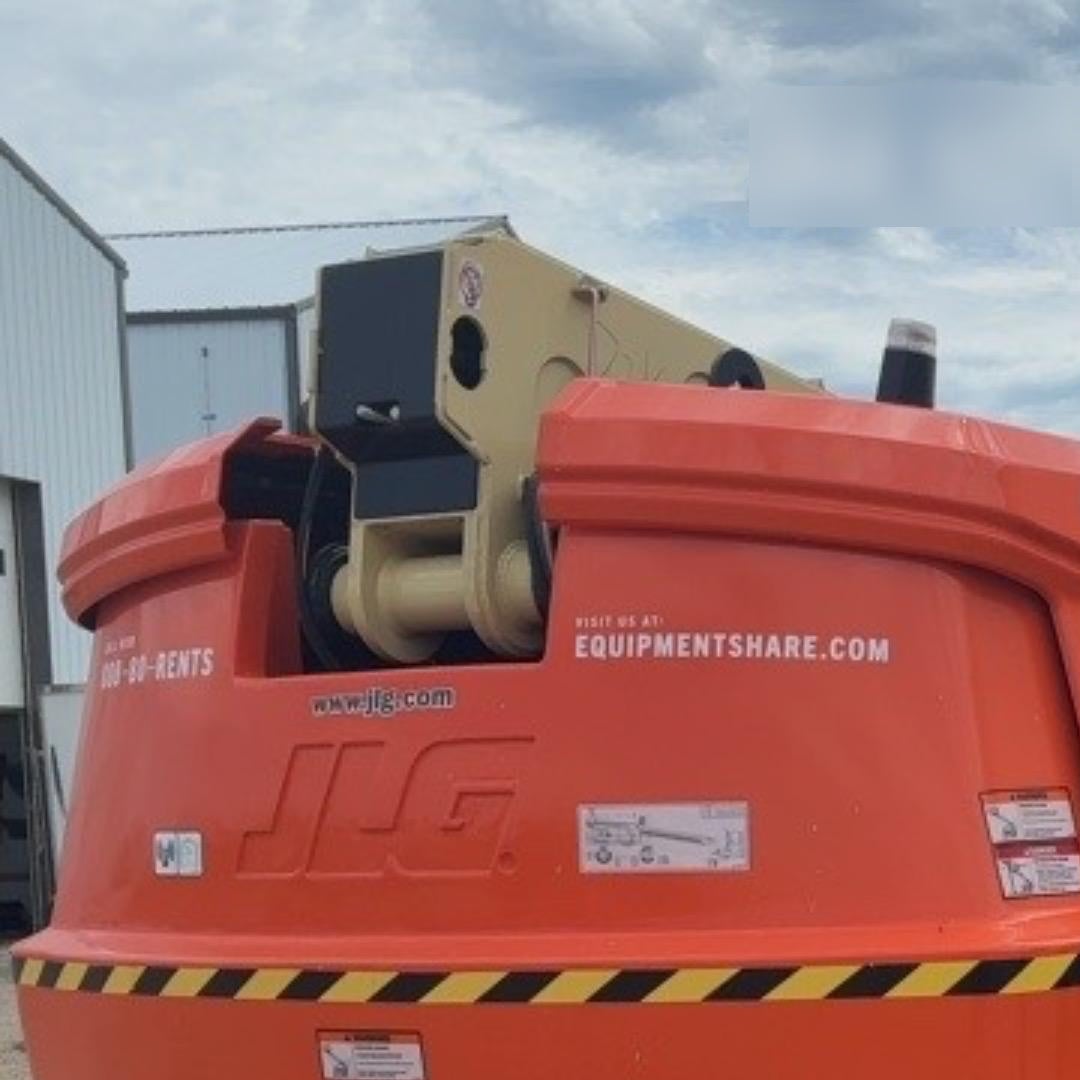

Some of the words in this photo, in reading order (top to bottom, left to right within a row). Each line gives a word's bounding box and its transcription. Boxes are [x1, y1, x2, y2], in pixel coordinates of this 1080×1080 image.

[575, 615, 612, 628] VISIT
[616, 615, 637, 628] US
[574, 632, 889, 664] EQUIPMENTSHARE.COM
[311, 686, 455, 718] www.jlg.com
